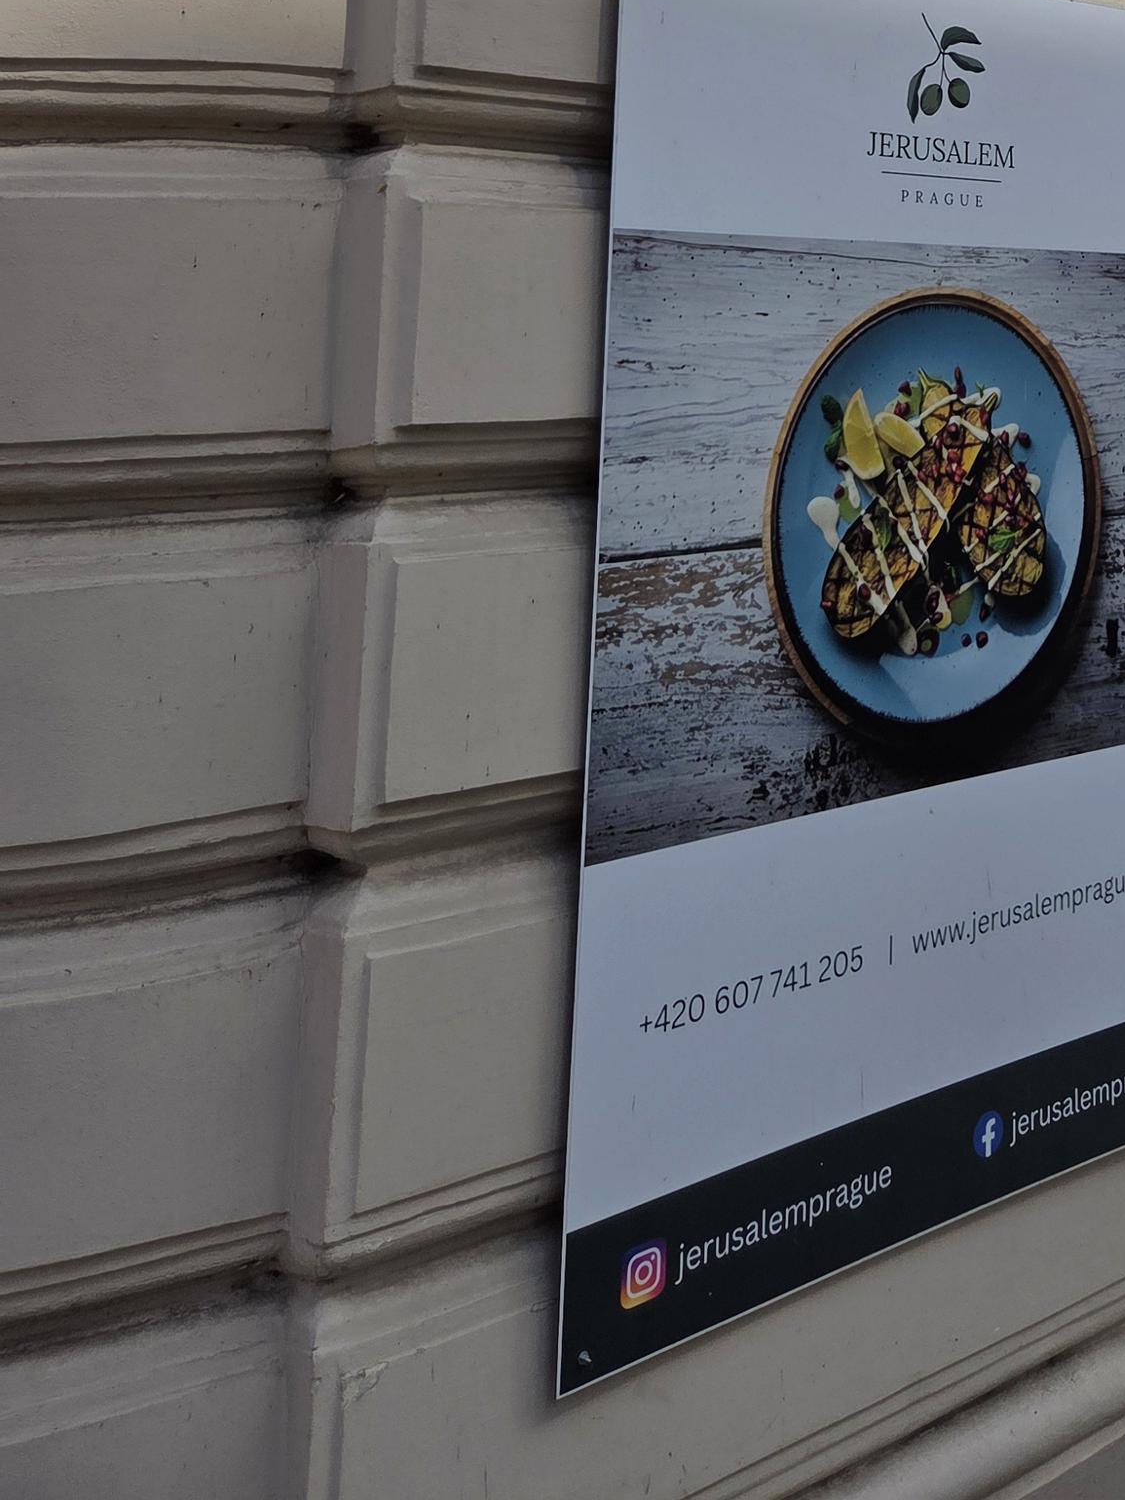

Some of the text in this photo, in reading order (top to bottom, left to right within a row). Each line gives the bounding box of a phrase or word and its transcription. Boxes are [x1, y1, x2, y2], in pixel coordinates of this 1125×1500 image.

[866, 131, 1015, 169] JERUSALEM
[901, 189, 983, 208] PRAGUE
[640, 994, 705, 1033] +420
[715, 975, 763, 1014] 607
[770, 961, 812, 998] 741
[818, 945, 863, 984] 205
[674, 1163, 893, 1285] jerusalemprague
